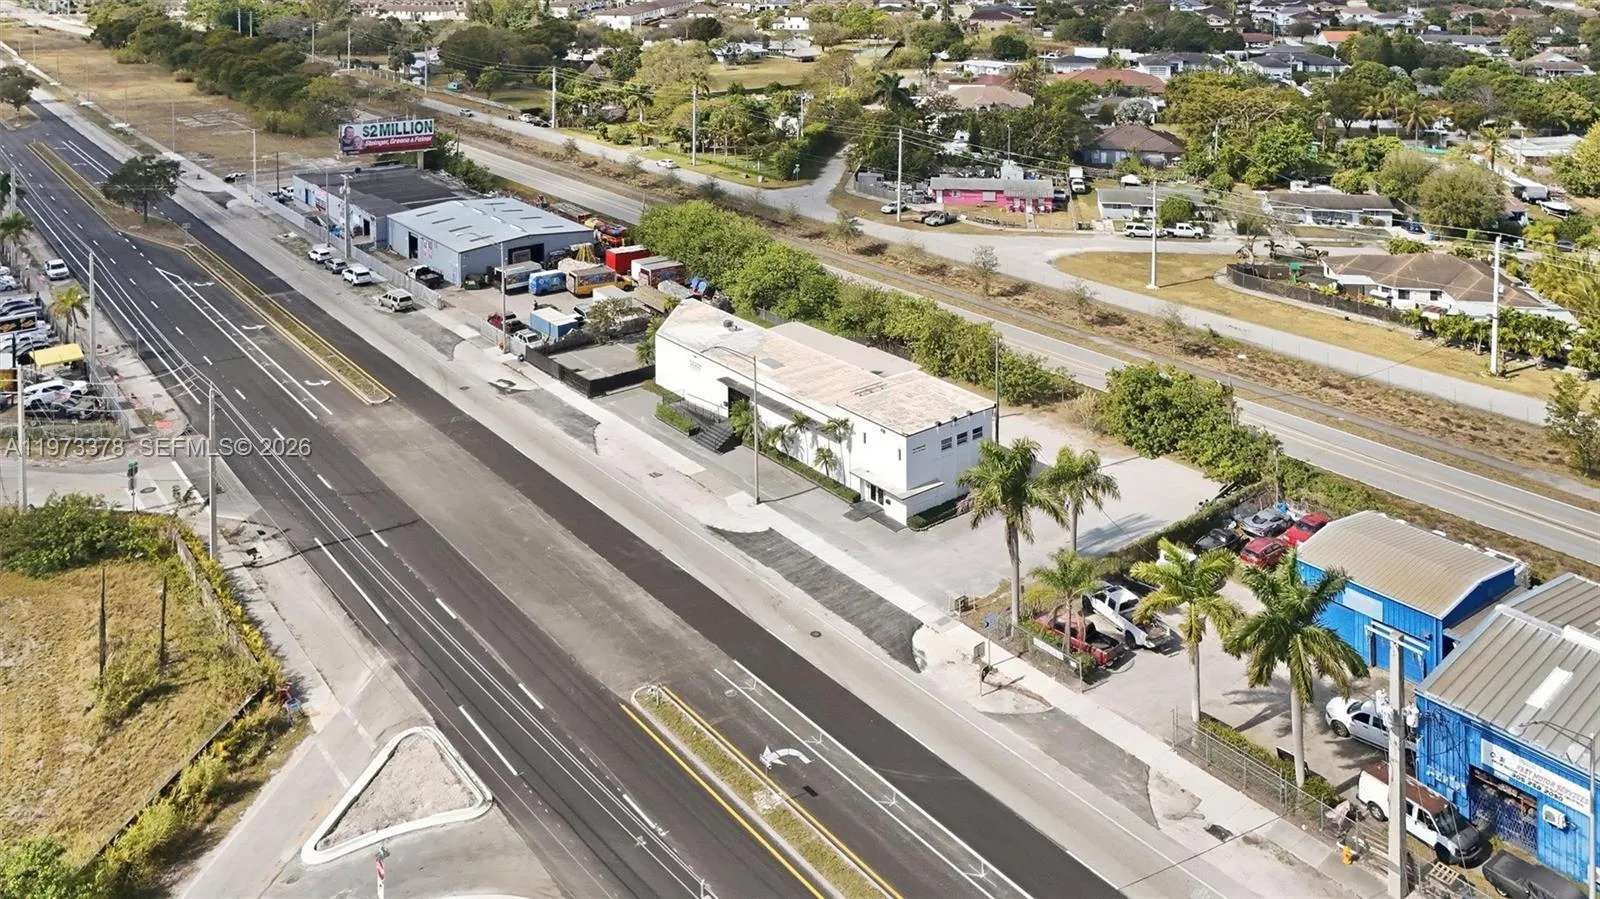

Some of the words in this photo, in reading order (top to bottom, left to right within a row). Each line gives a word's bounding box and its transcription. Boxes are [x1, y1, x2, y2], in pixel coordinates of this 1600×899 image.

[362, 124, 378, 137] $2
[379, 120, 433, 136] MILLION
[1533, 772, 1556, 787] MOTOR
